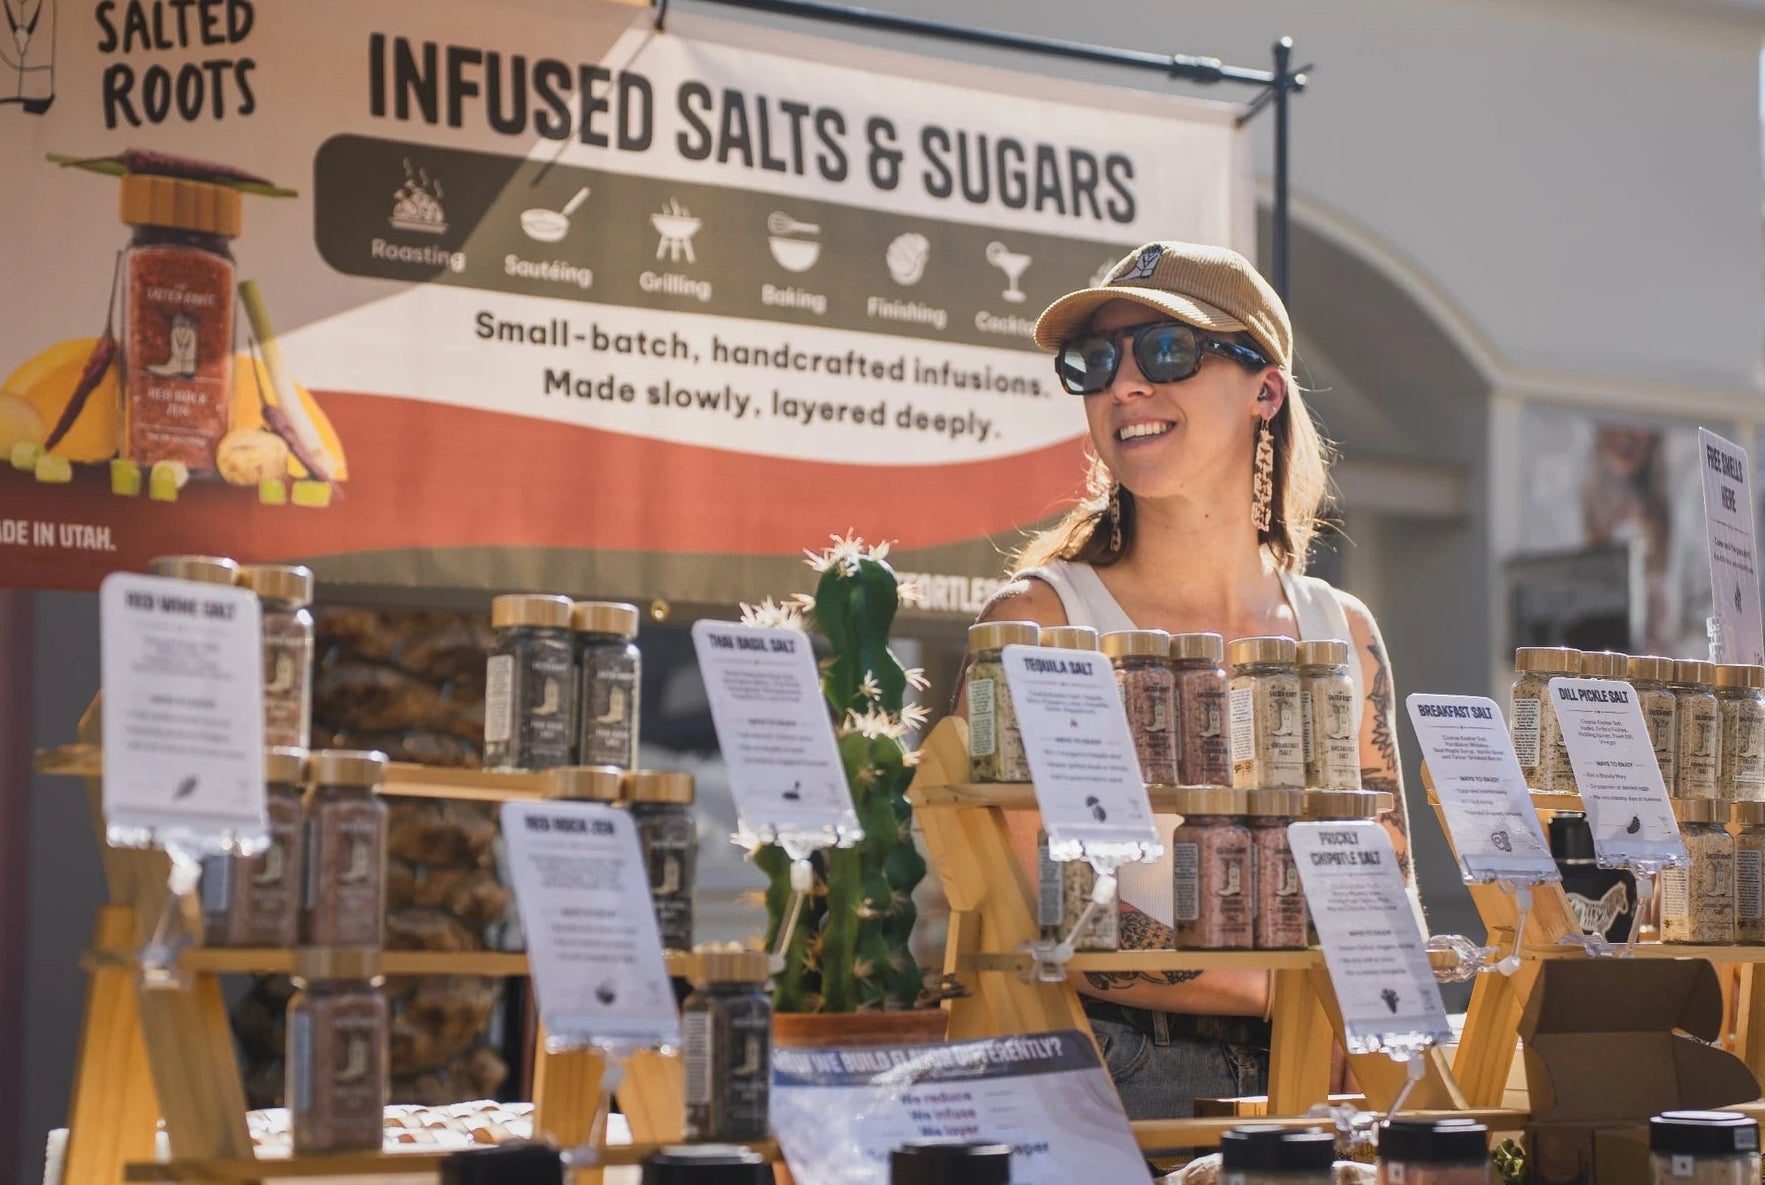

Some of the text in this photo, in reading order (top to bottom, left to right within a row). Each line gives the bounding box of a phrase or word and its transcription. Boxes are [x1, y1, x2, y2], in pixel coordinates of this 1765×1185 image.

[95, 0, 256, 53] SALTED
[103, 58, 257, 130] ROOTS
[369, 32, 1137, 224] INFUSED SALTS & SUGARS
[371, 237, 467, 273] Roasting
[639, 270, 712, 303] Grilling
[761, 282, 827, 315] Baking
[867, 296, 948, 331] Finishing
[474, 310, 1051, 400] Small-batch, handcrafted infusions.
[542, 367, 1002, 444] Made slowly, layered deeply.
[1706, 444, 1722, 473] FREE
[33, 520, 54, 547] IN
[59, 522, 118, 552] UTAH.
[769, 639, 795, 654] SALT
[1023, 657, 1093, 676] TEQUILA SALT
[1417, 703, 1493, 720] BREAKFAST SALT
[1558, 687, 1629, 704] DILL PICKLE SALT
[1357, 850, 1381, 866] SALT
